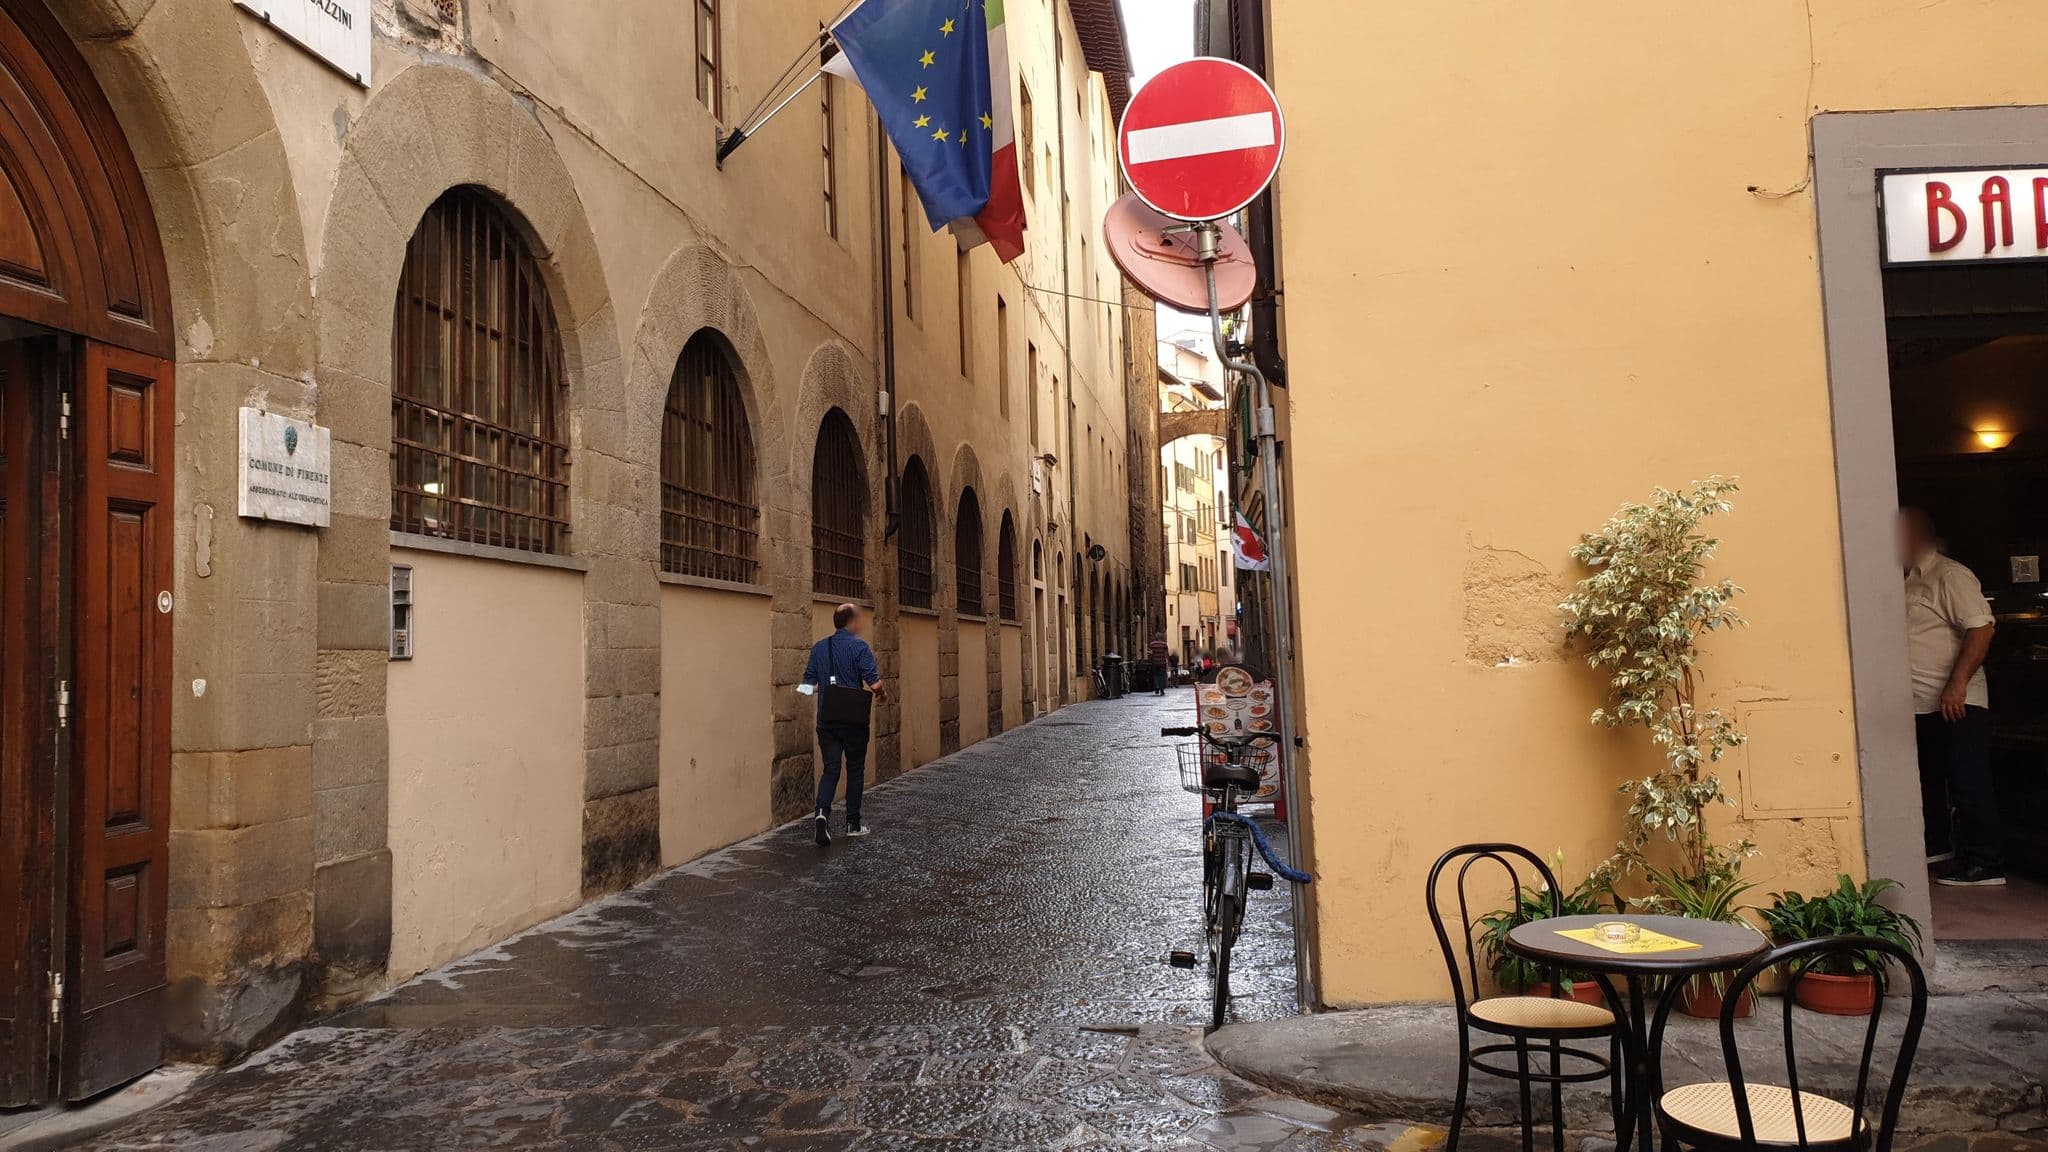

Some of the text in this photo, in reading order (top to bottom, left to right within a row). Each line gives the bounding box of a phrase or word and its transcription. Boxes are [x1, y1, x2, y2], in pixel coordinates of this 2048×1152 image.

[310, 0, 352, 30] AZZINI
[248, 458, 329, 484] COMUNE DI FIRENZE
